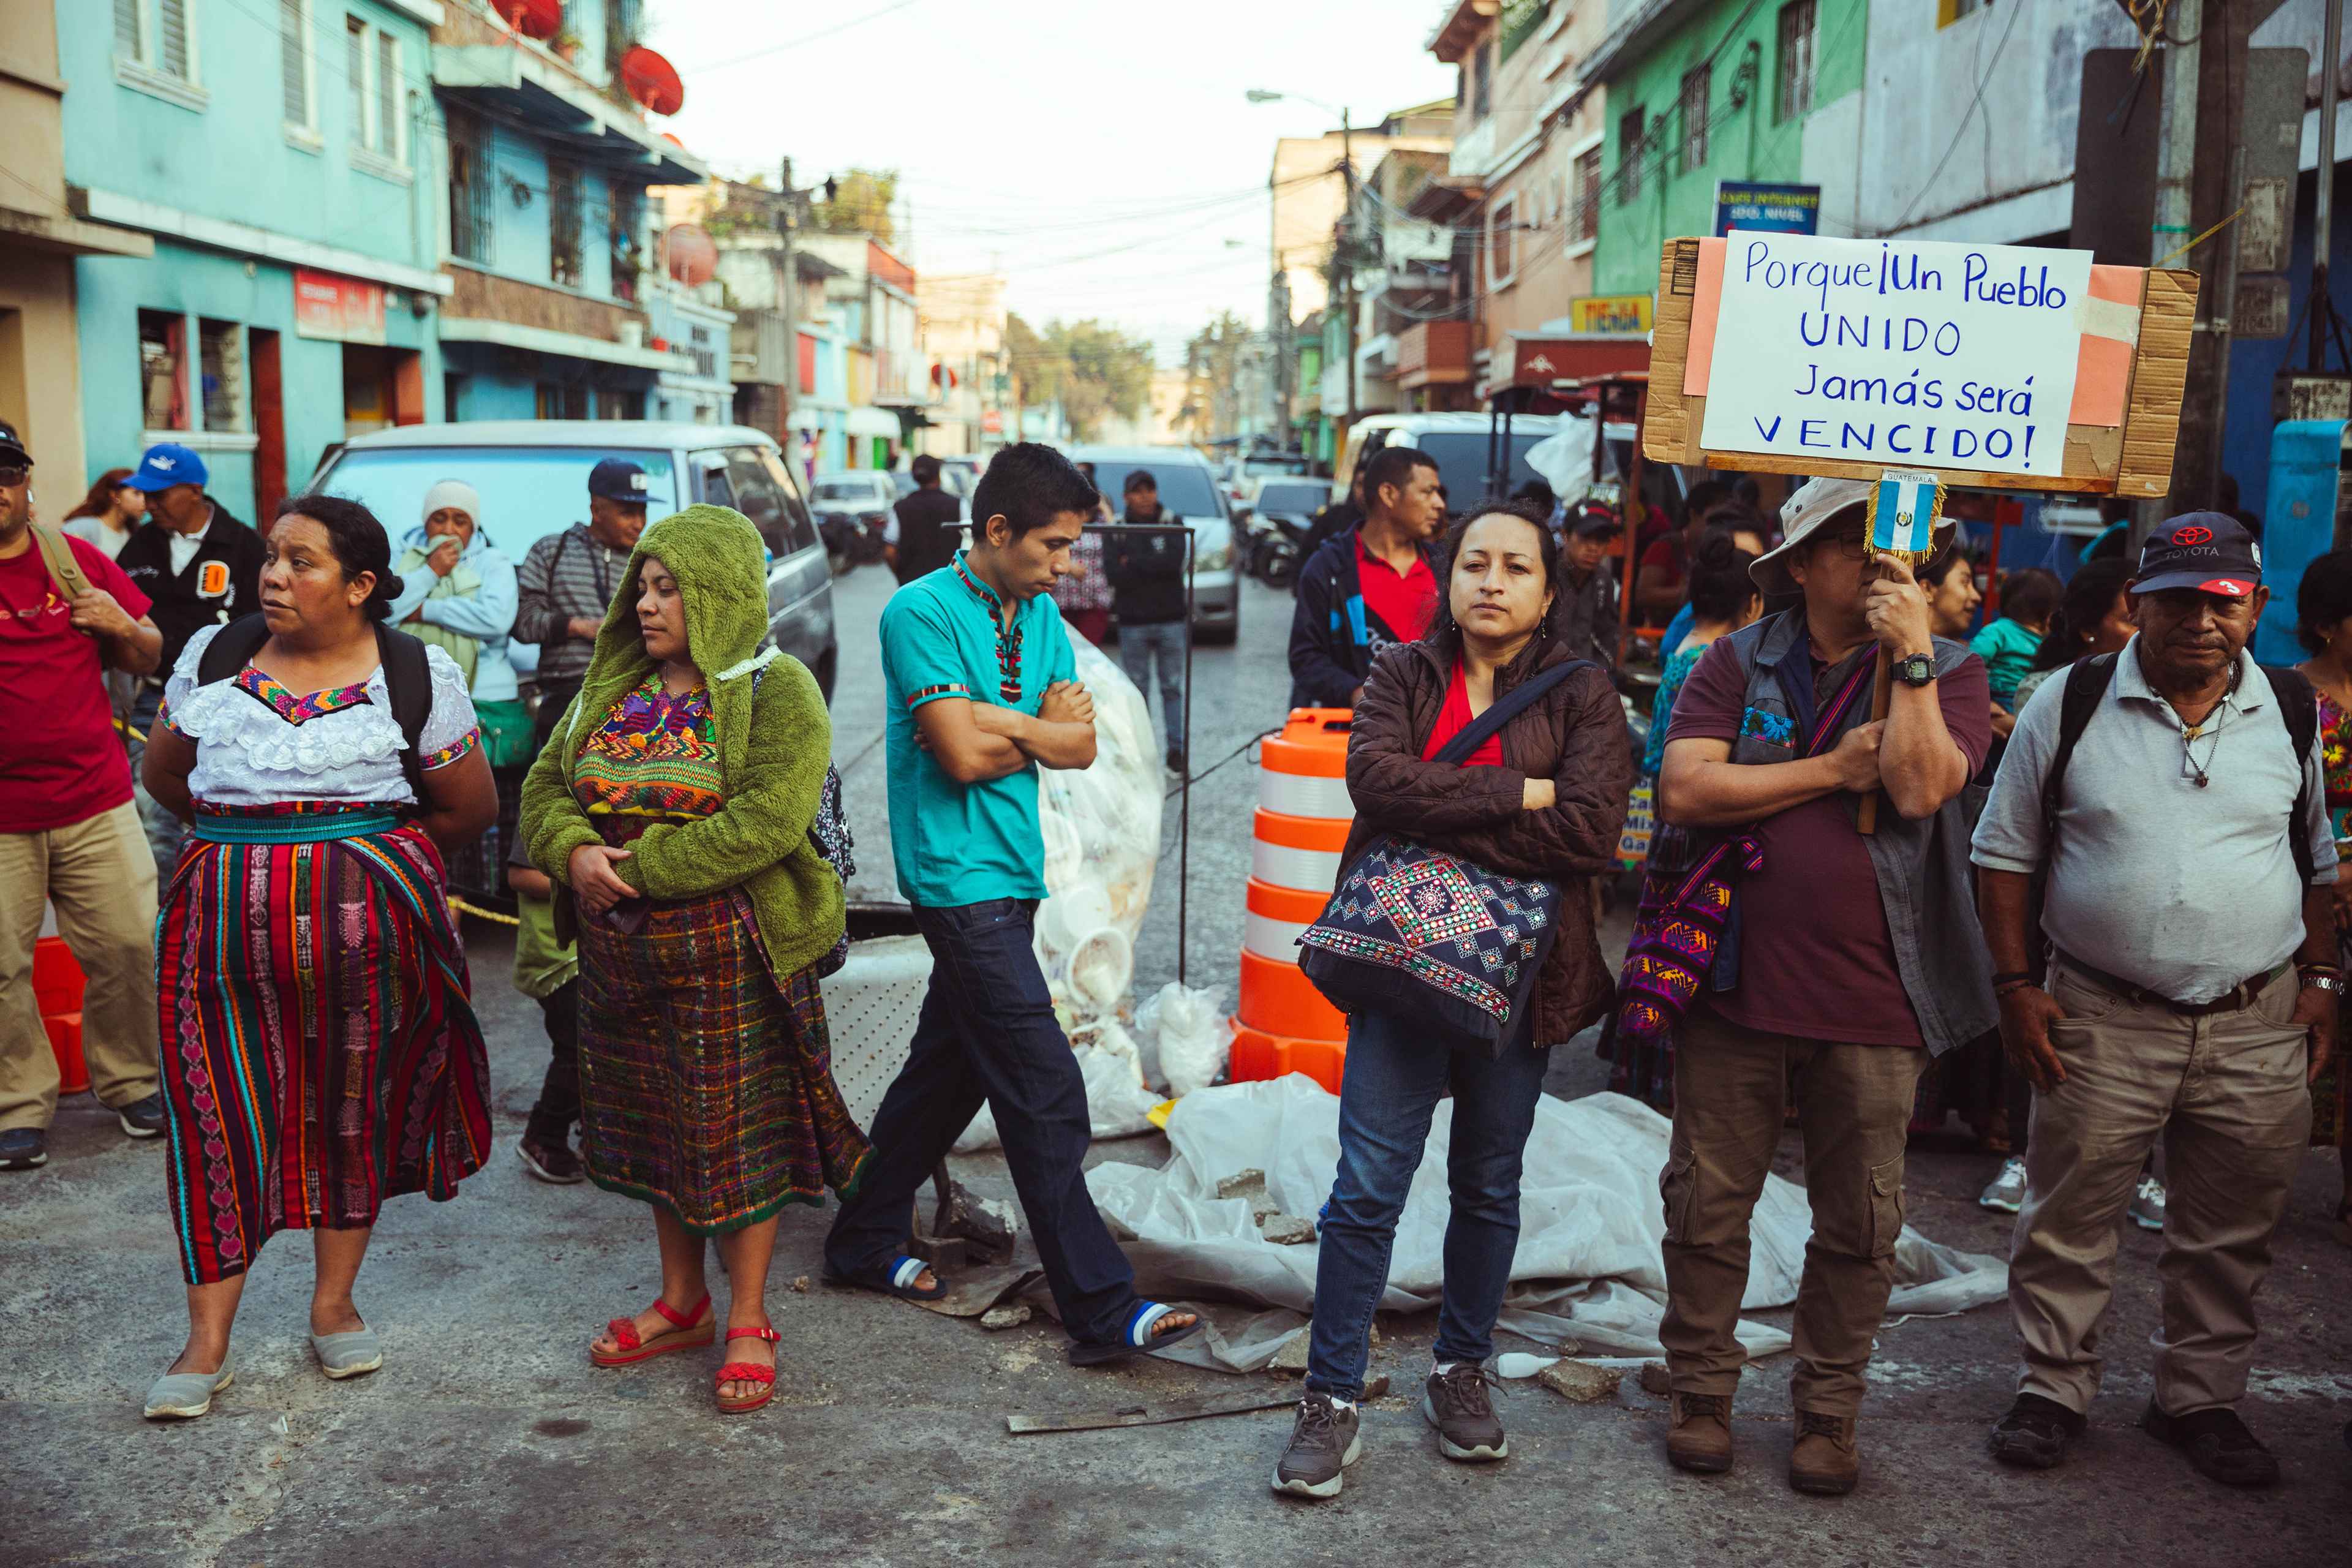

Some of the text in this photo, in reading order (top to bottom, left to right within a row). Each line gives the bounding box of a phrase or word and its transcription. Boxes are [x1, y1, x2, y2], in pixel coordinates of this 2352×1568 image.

[1746, 241, 1873, 312] Porque
[1964, 252, 2067, 310] Pueblo
[1800, 312, 1961, 357] UNIDO
[1794, 364, 2034, 418] Jamás será
[1754, 415, 2037, 469] VENCIDO!
[1888, 474, 1932, 483] GUATEMALA
[2165, 546, 2220, 560] TOYOTA
